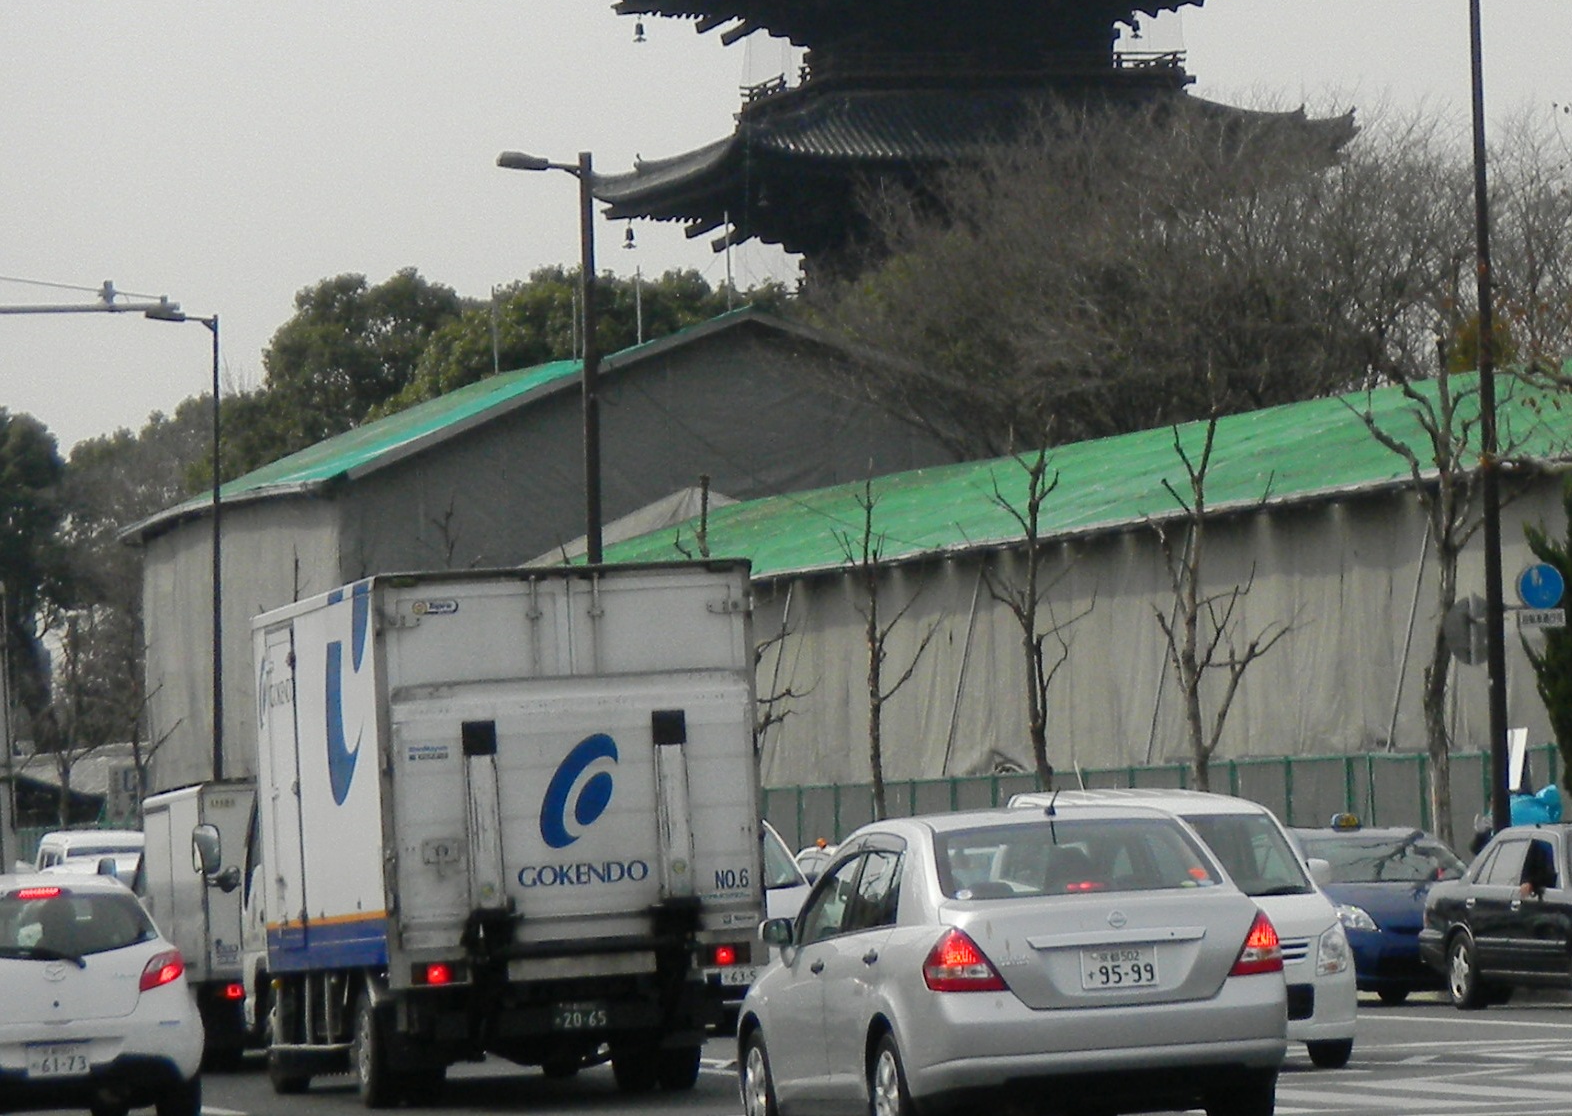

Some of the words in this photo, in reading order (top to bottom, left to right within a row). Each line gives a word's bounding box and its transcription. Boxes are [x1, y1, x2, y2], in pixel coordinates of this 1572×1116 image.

[517, 859, 649, 887] GOKENDO
[715, 868, 749, 889] NO.6
[1099, 963, 1155, 985] 95-99
[563, 1010, 607, 1028] 20-65
[41, 1055, 87, 1072] 61-73
